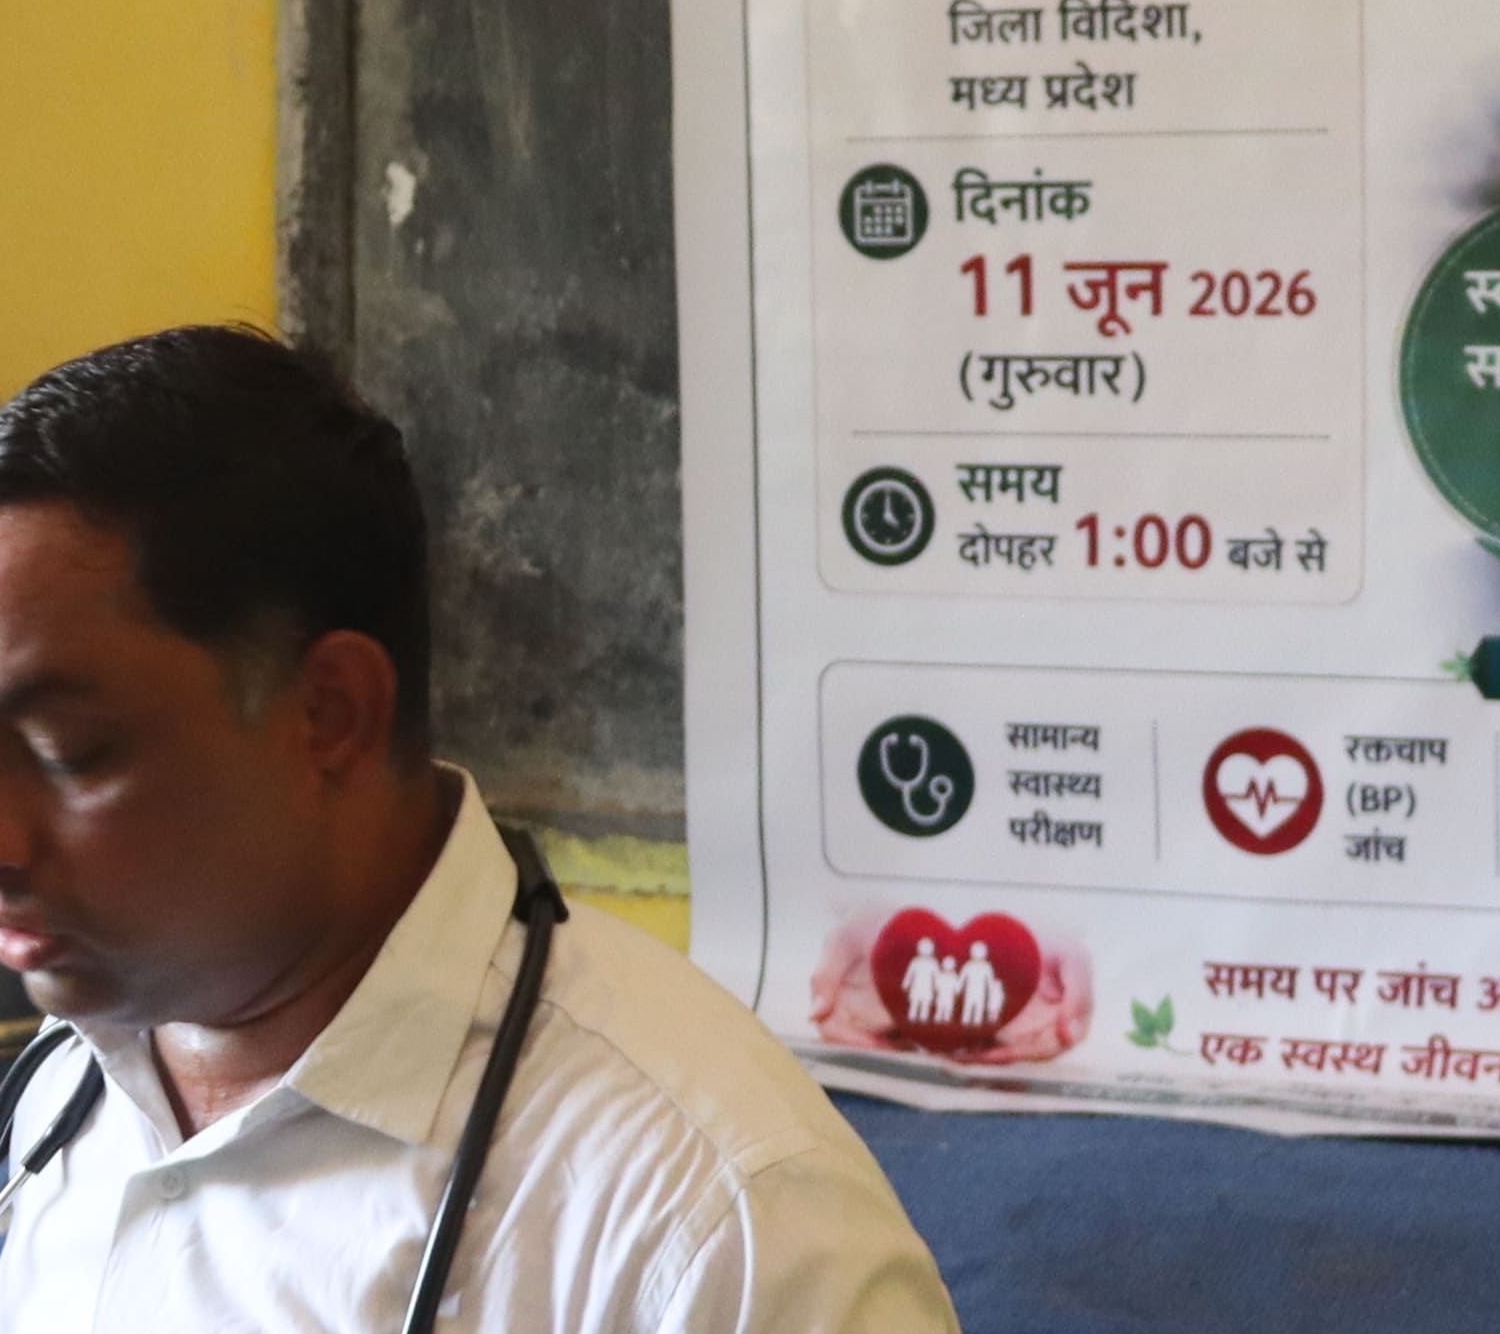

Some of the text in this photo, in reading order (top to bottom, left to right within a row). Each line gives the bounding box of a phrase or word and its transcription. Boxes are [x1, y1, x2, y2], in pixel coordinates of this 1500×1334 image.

[949, 61, 1137, 111] मध्य प्रदेश
[953, 166, 1092, 227] दिनांक
[960, 254, 1317, 338] 11 जून 2026
[959, 350, 1147, 410] (गुरुवार)
[954, 462, 1063, 505] समय
[957, 512, 1328, 573] दोपहर 1:00 बजे से
[1006, 723, 1101, 754] सामान्य
[1344, 734, 1446, 769] रक्तचाप
[1006, 771, 1102, 802] स्वास्थ्य
[1345, 782, 1419, 821] (BP)
[1009, 809, 1105, 850] परीक्षण
[1345, 825, 1408, 863] जांच
[1204, 962, 1298, 1001] समय
[1312, 968, 1363, 1005] पर
[1376, 964, 1460, 1012] जांच
[1200, 1033, 1264, 1069] एक
[1279, 1038, 1386, 1075] स्वस्थ
